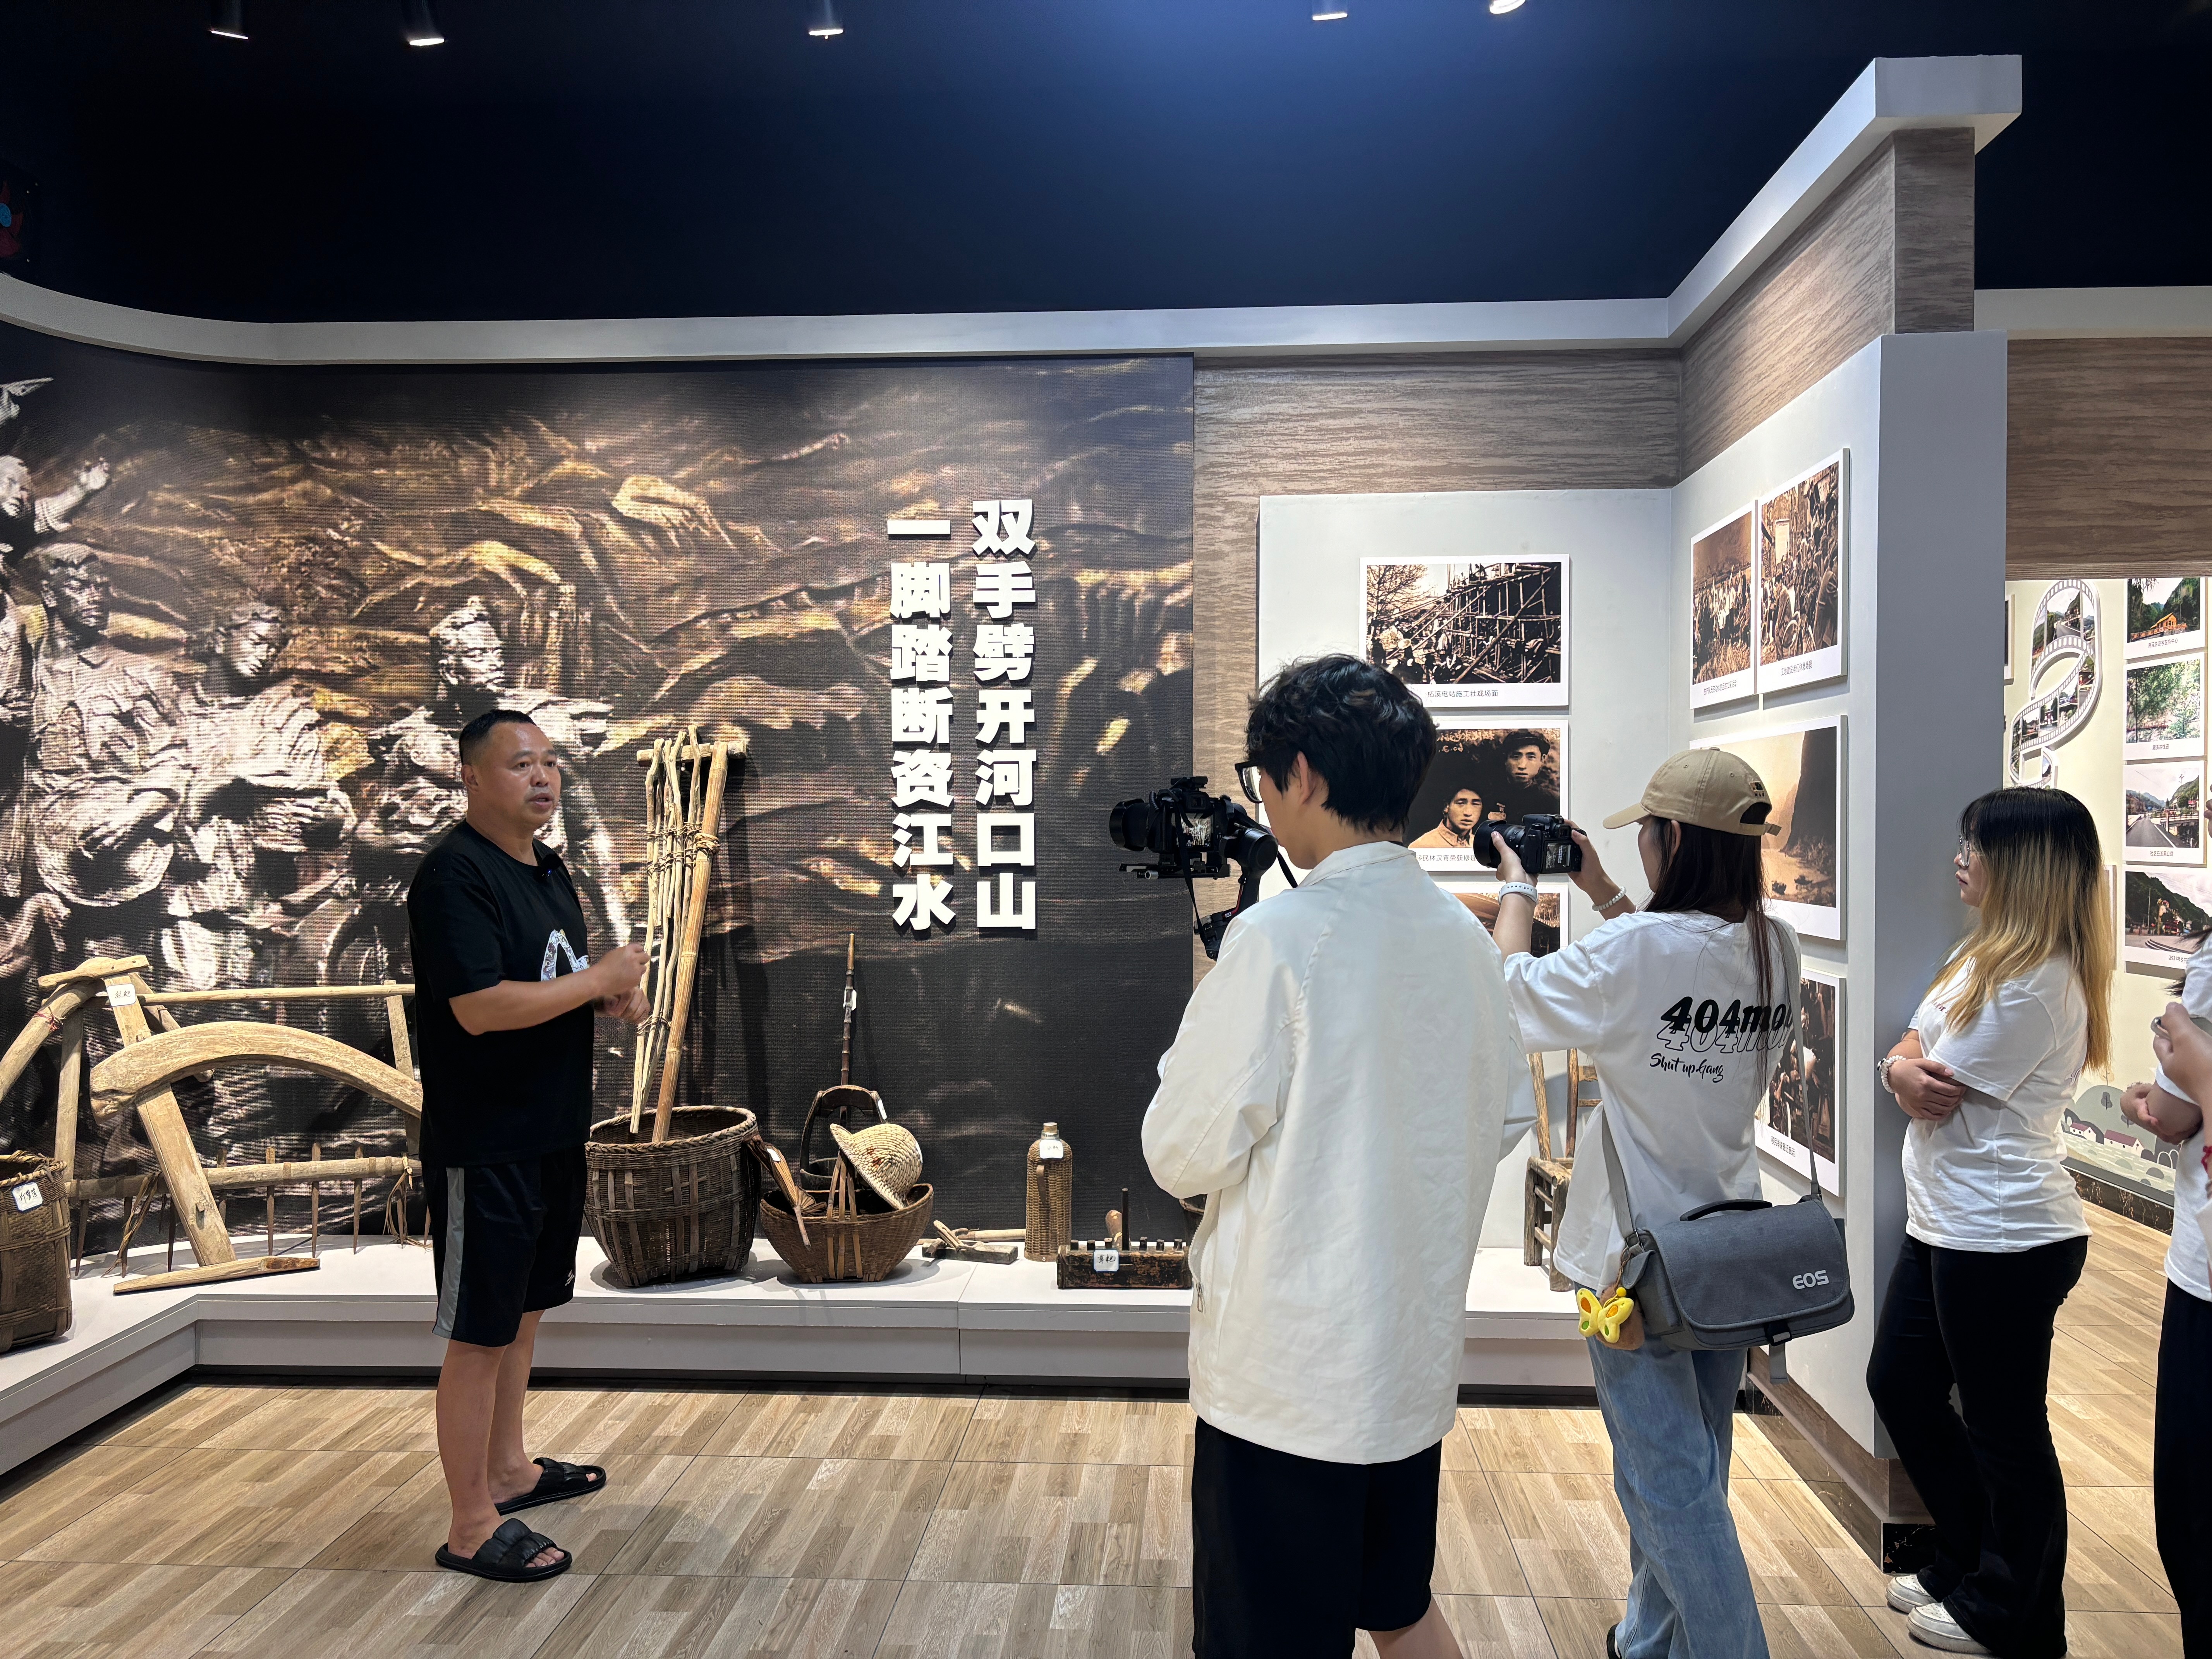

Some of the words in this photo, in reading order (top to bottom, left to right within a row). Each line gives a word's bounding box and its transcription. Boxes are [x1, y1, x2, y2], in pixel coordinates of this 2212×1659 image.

[887, 519, 956, 931] 一脚踏断资江水
[972, 499, 1037, 930] 双手劈开河口山
[1650, 1053, 1685, 1072] Shut
[1682, 1065, 1696, 1078] up
[1792, 1270, 1829, 1290] EOS
